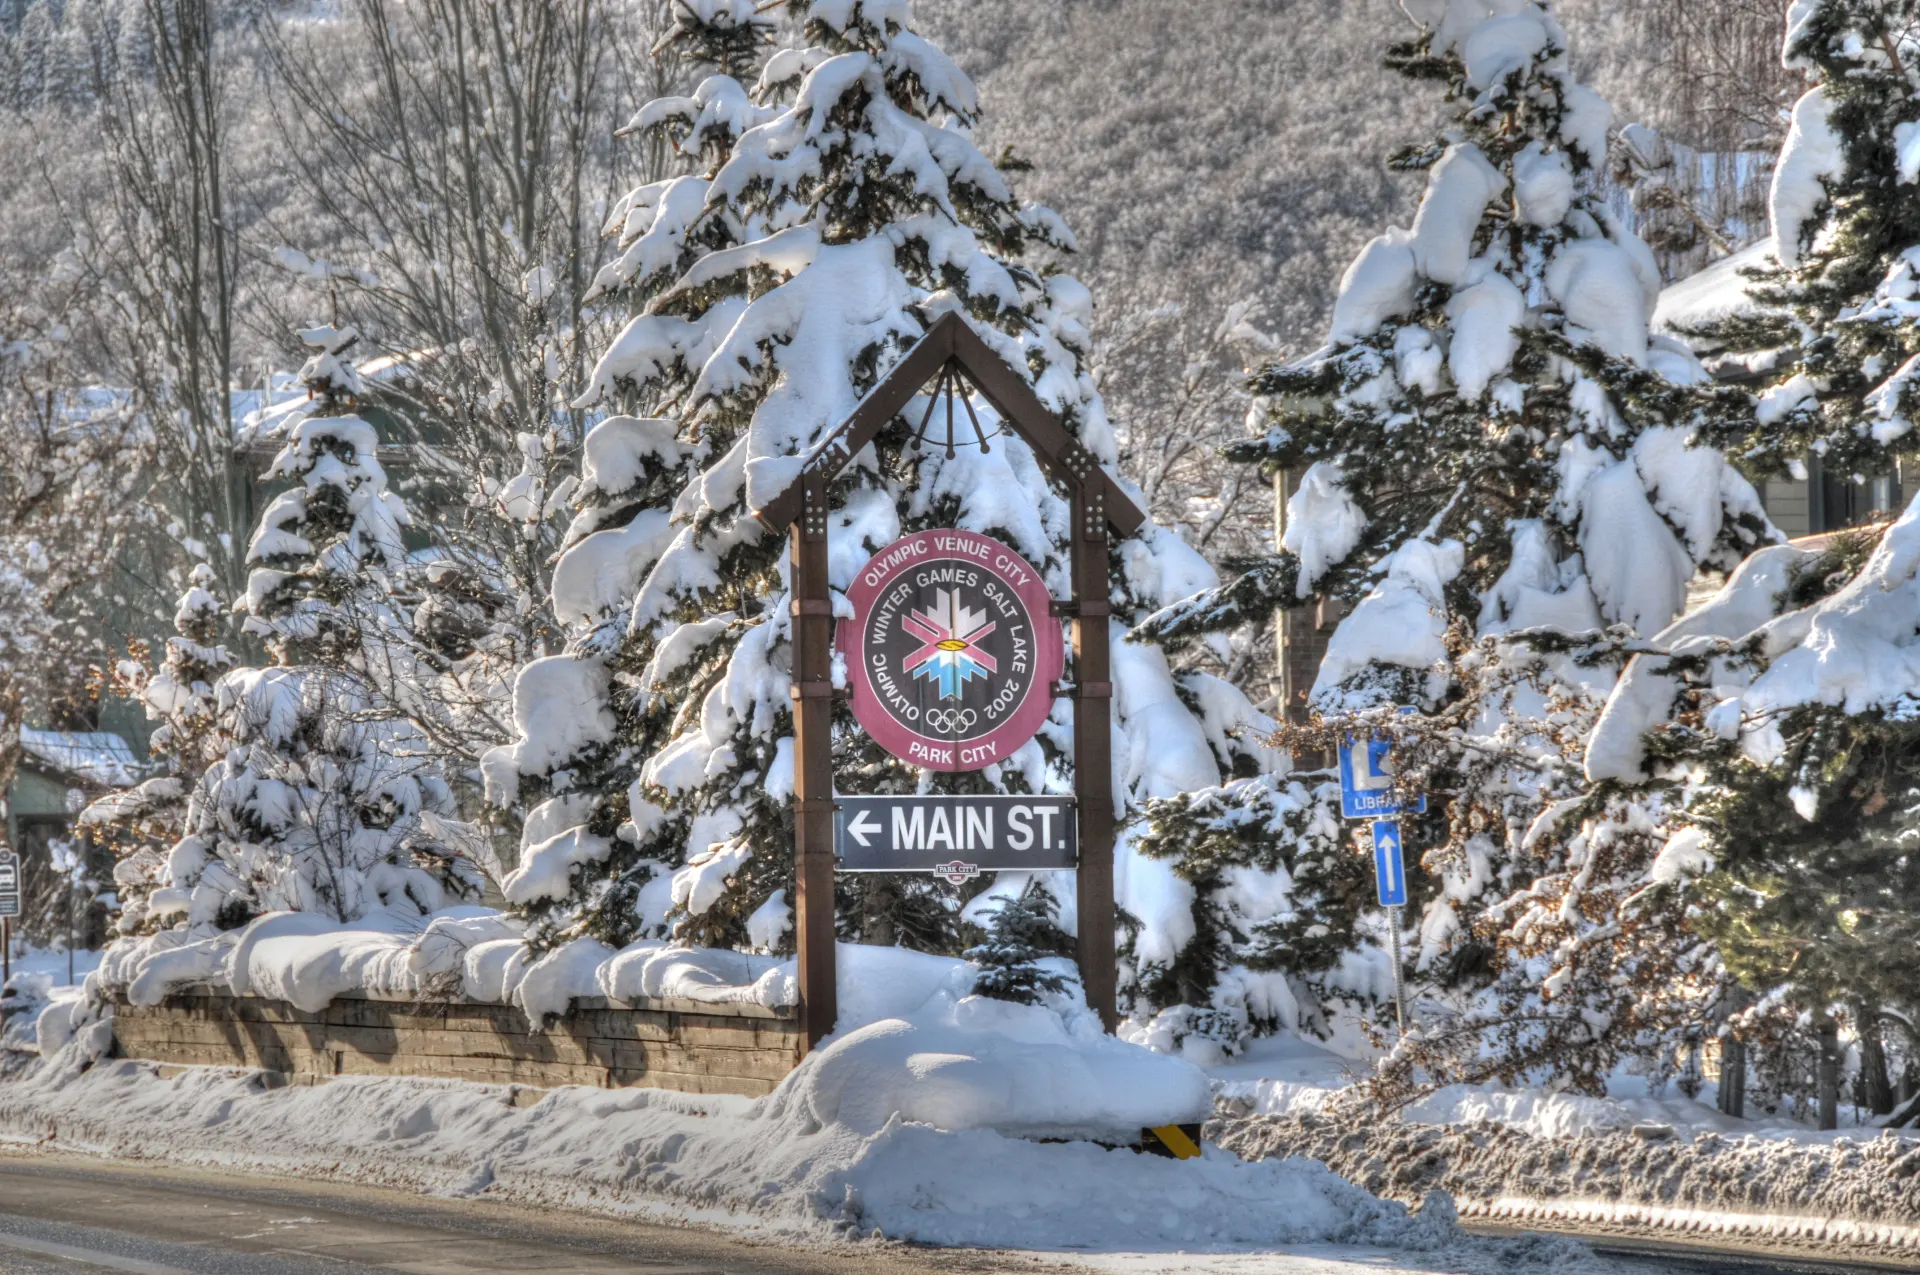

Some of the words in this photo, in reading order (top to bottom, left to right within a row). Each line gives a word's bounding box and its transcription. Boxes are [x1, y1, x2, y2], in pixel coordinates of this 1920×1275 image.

[865, 539, 928, 587] OLYMPIC
[934, 537, 991, 560] VENUE
[995, 555, 1031, 586] CITY
[916, 568, 978, 588] GAMES
[872, 582, 913, 645] WINTER
[983, 582, 1018, 618] SALT
[1010, 624, 1027, 675] LAKE
[872, 653, 920, 721] OLYMPIC
[983, 678, 1020, 720] 2002
[908, 741, 953, 765] PARK
[960, 741, 998, 764] CITY
[891, 805, 993, 851] MAIN
[1006, 804, 1066, 851] ST.
